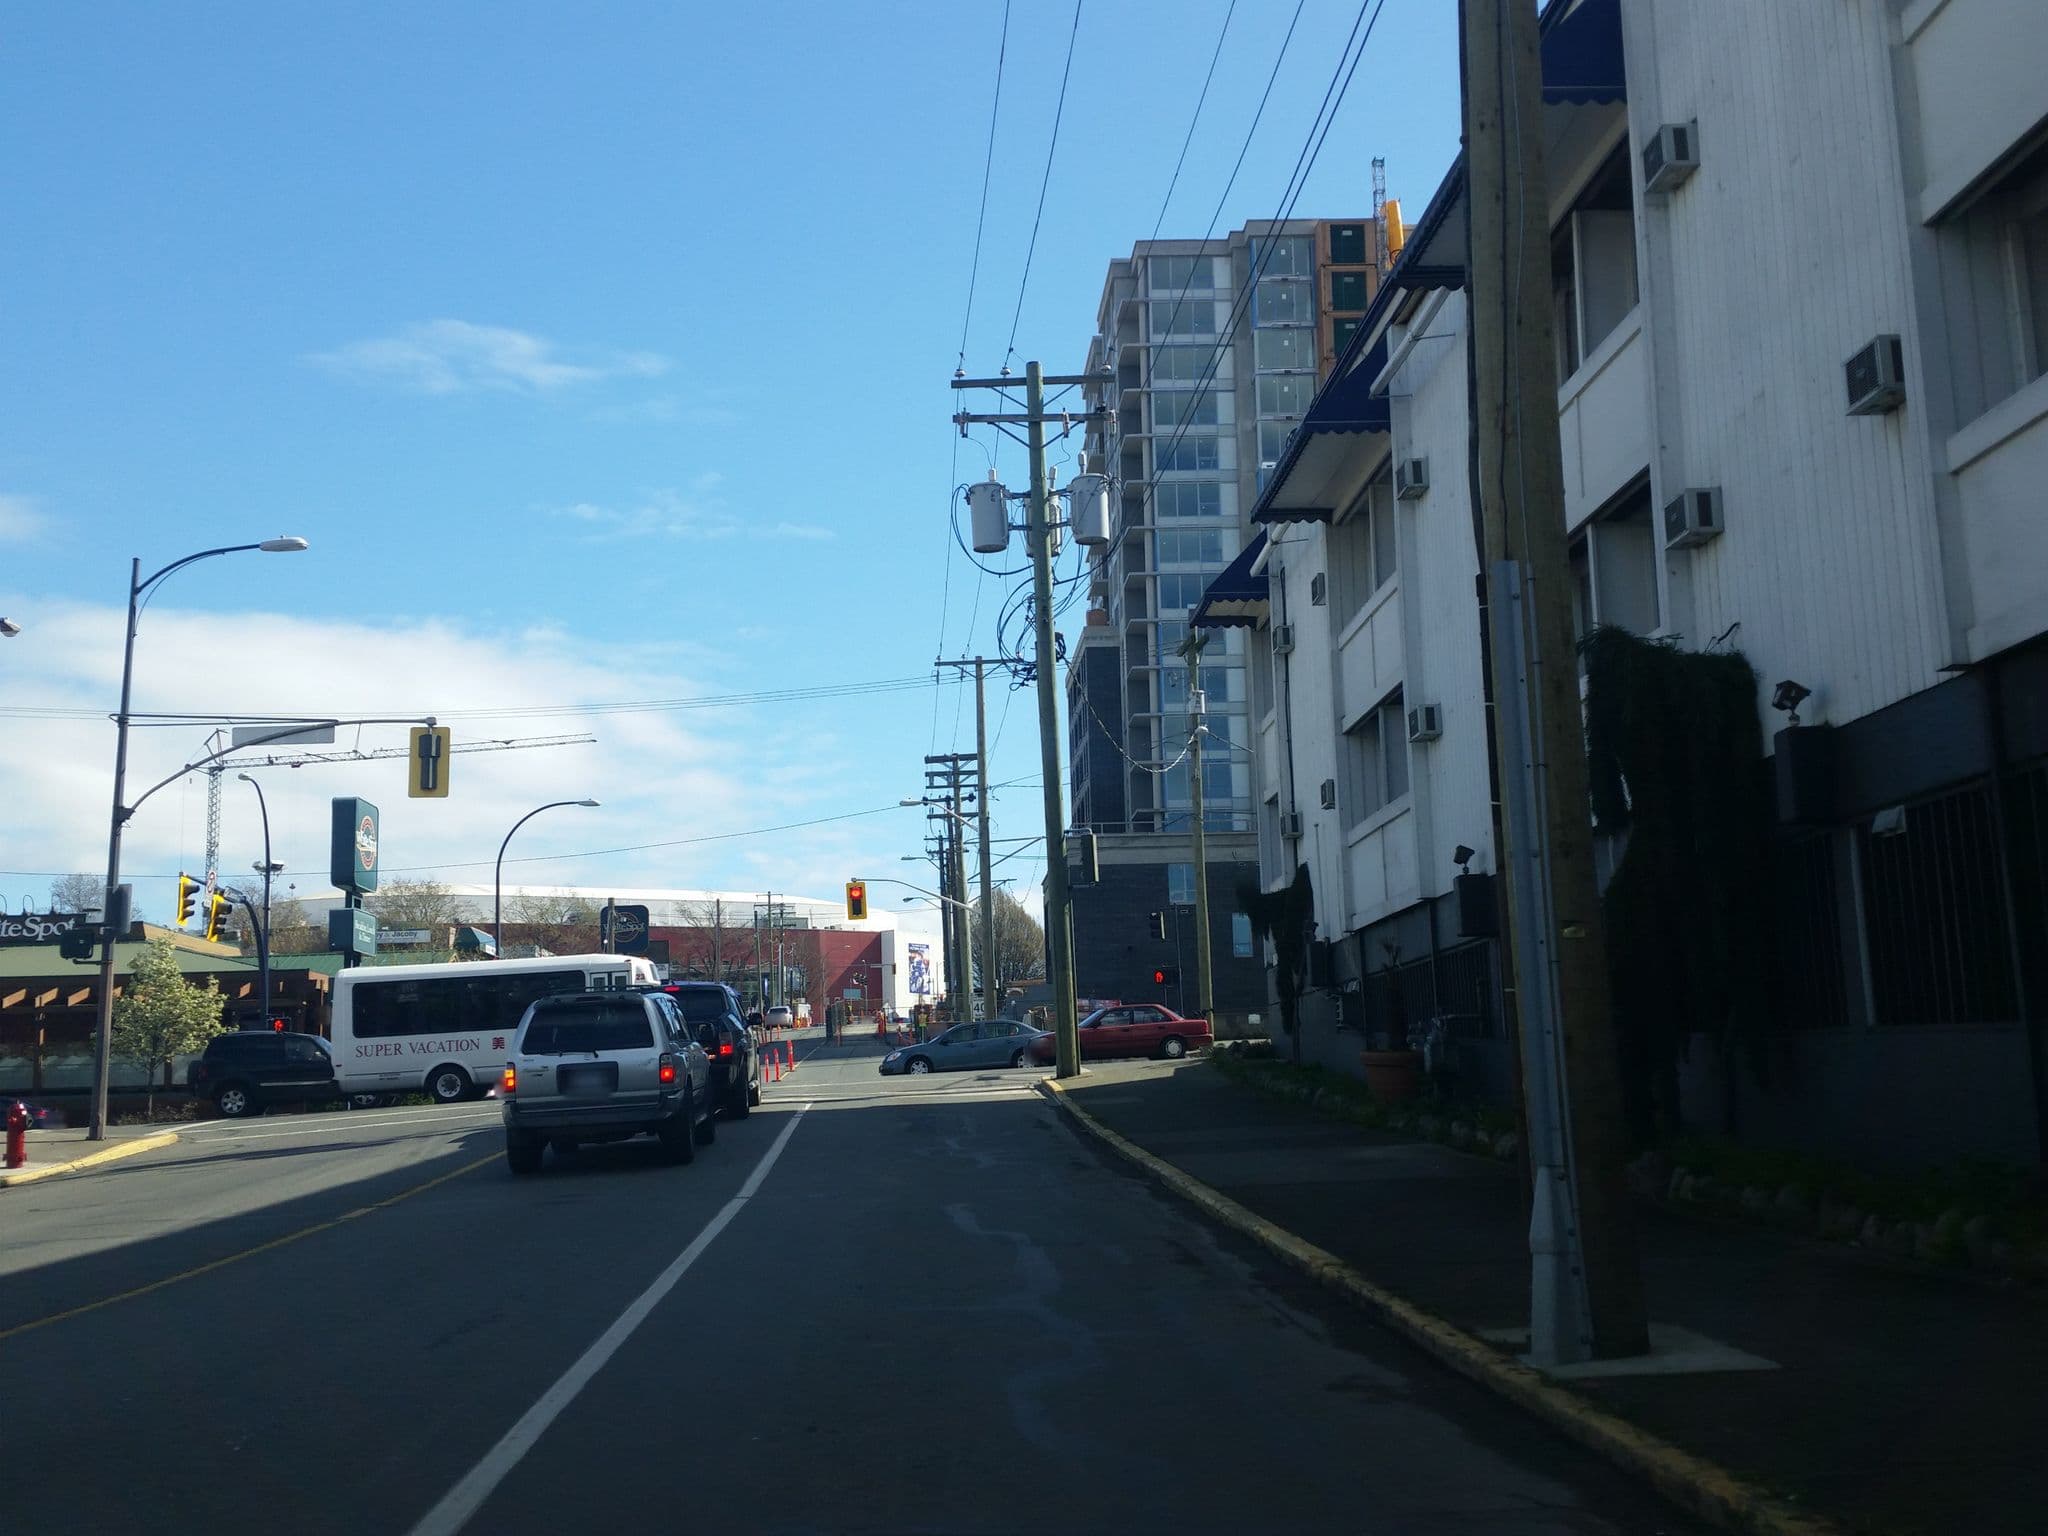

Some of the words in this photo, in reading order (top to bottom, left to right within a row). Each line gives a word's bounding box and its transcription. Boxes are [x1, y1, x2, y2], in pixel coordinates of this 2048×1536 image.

[392, 931, 417, 939] Jacoby
[356, 1043, 403, 1058] SUPER
[408, 1038, 481, 1054] VACATION
